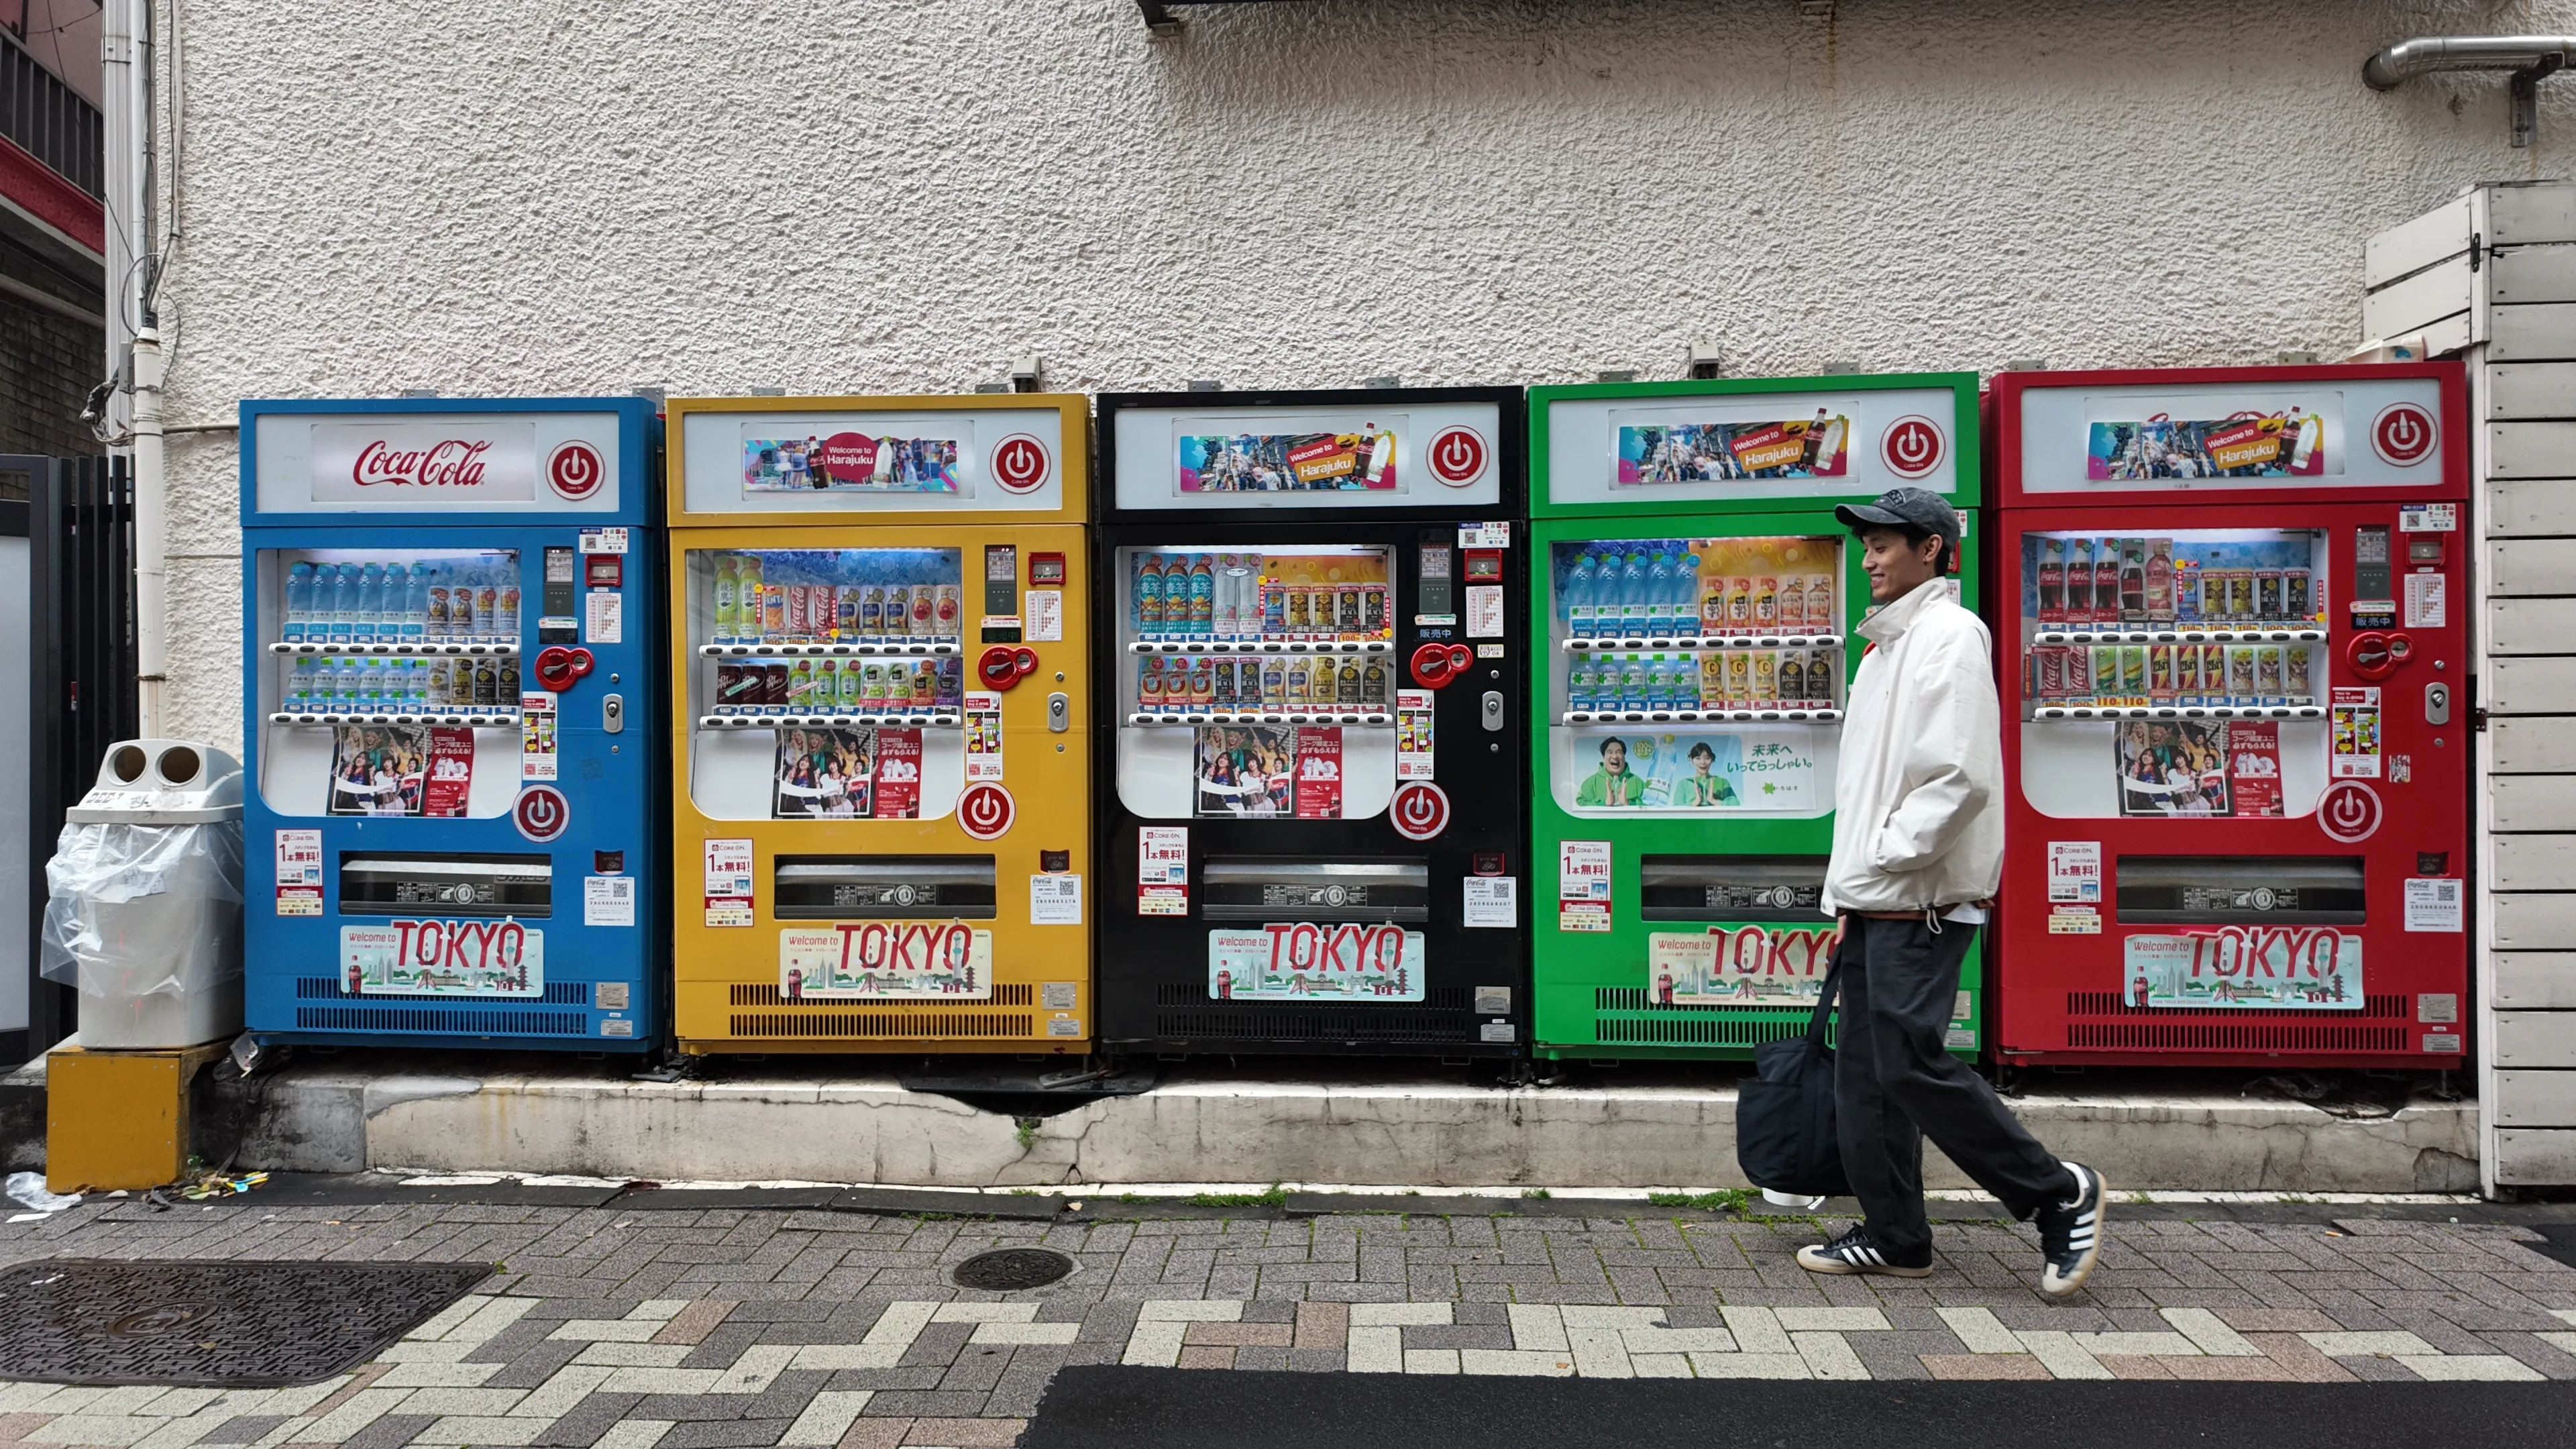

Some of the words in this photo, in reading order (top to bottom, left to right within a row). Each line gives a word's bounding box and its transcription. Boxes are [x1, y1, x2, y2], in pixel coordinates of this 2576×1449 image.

[1733, 435, 1770, 451] Welcome
[1770, 431, 1780, 440] to
[2207, 431, 2244, 449] Welcome
[2244, 429, 2254, 437] to
[828, 446, 863, 454] Welcome
[1289, 445, 1323, 463] Welcome
[1324, 443, 1333, 452] to
[1745, 447, 1799, 466] Harajuku
[2218, 445, 2275, 464] Harajuku
[353, 440, 494, 486] Coca-Cola
[827, 455, 873, 466] Harajuku
[1300, 460, 1351, 477] Harajuku
[2356, 616, 2391, 626] 販売中
[1419, 629, 1452, 639] 販売中
[1752, 743, 1792, 757] 未来へ
[1727, 757, 1813, 773] いってらっしゃい。
[349, 932, 386, 942] Welcome
[388, 934, 396, 942] to
[394, 921, 524, 969] TOKYO
[789, 935, 827, 945] Welcome
[830, 937, 838, 945] to
[836, 924, 972, 969] TOKYO
[1218, 936, 1256, 947] Welcome
[1259, 938, 1267, 947] to
[1265, 925, 1403, 972] TOKYO
[1658, 939, 1699, 949] Welcome
[1702, 941, 1711, 949] to
[1709, 928, 1837, 975] TOKY
[2134, 941, 2176, 952] Welcome
[2180, 943, 2189, 951] to
[2189, 928, 2340, 978] TOKYO
